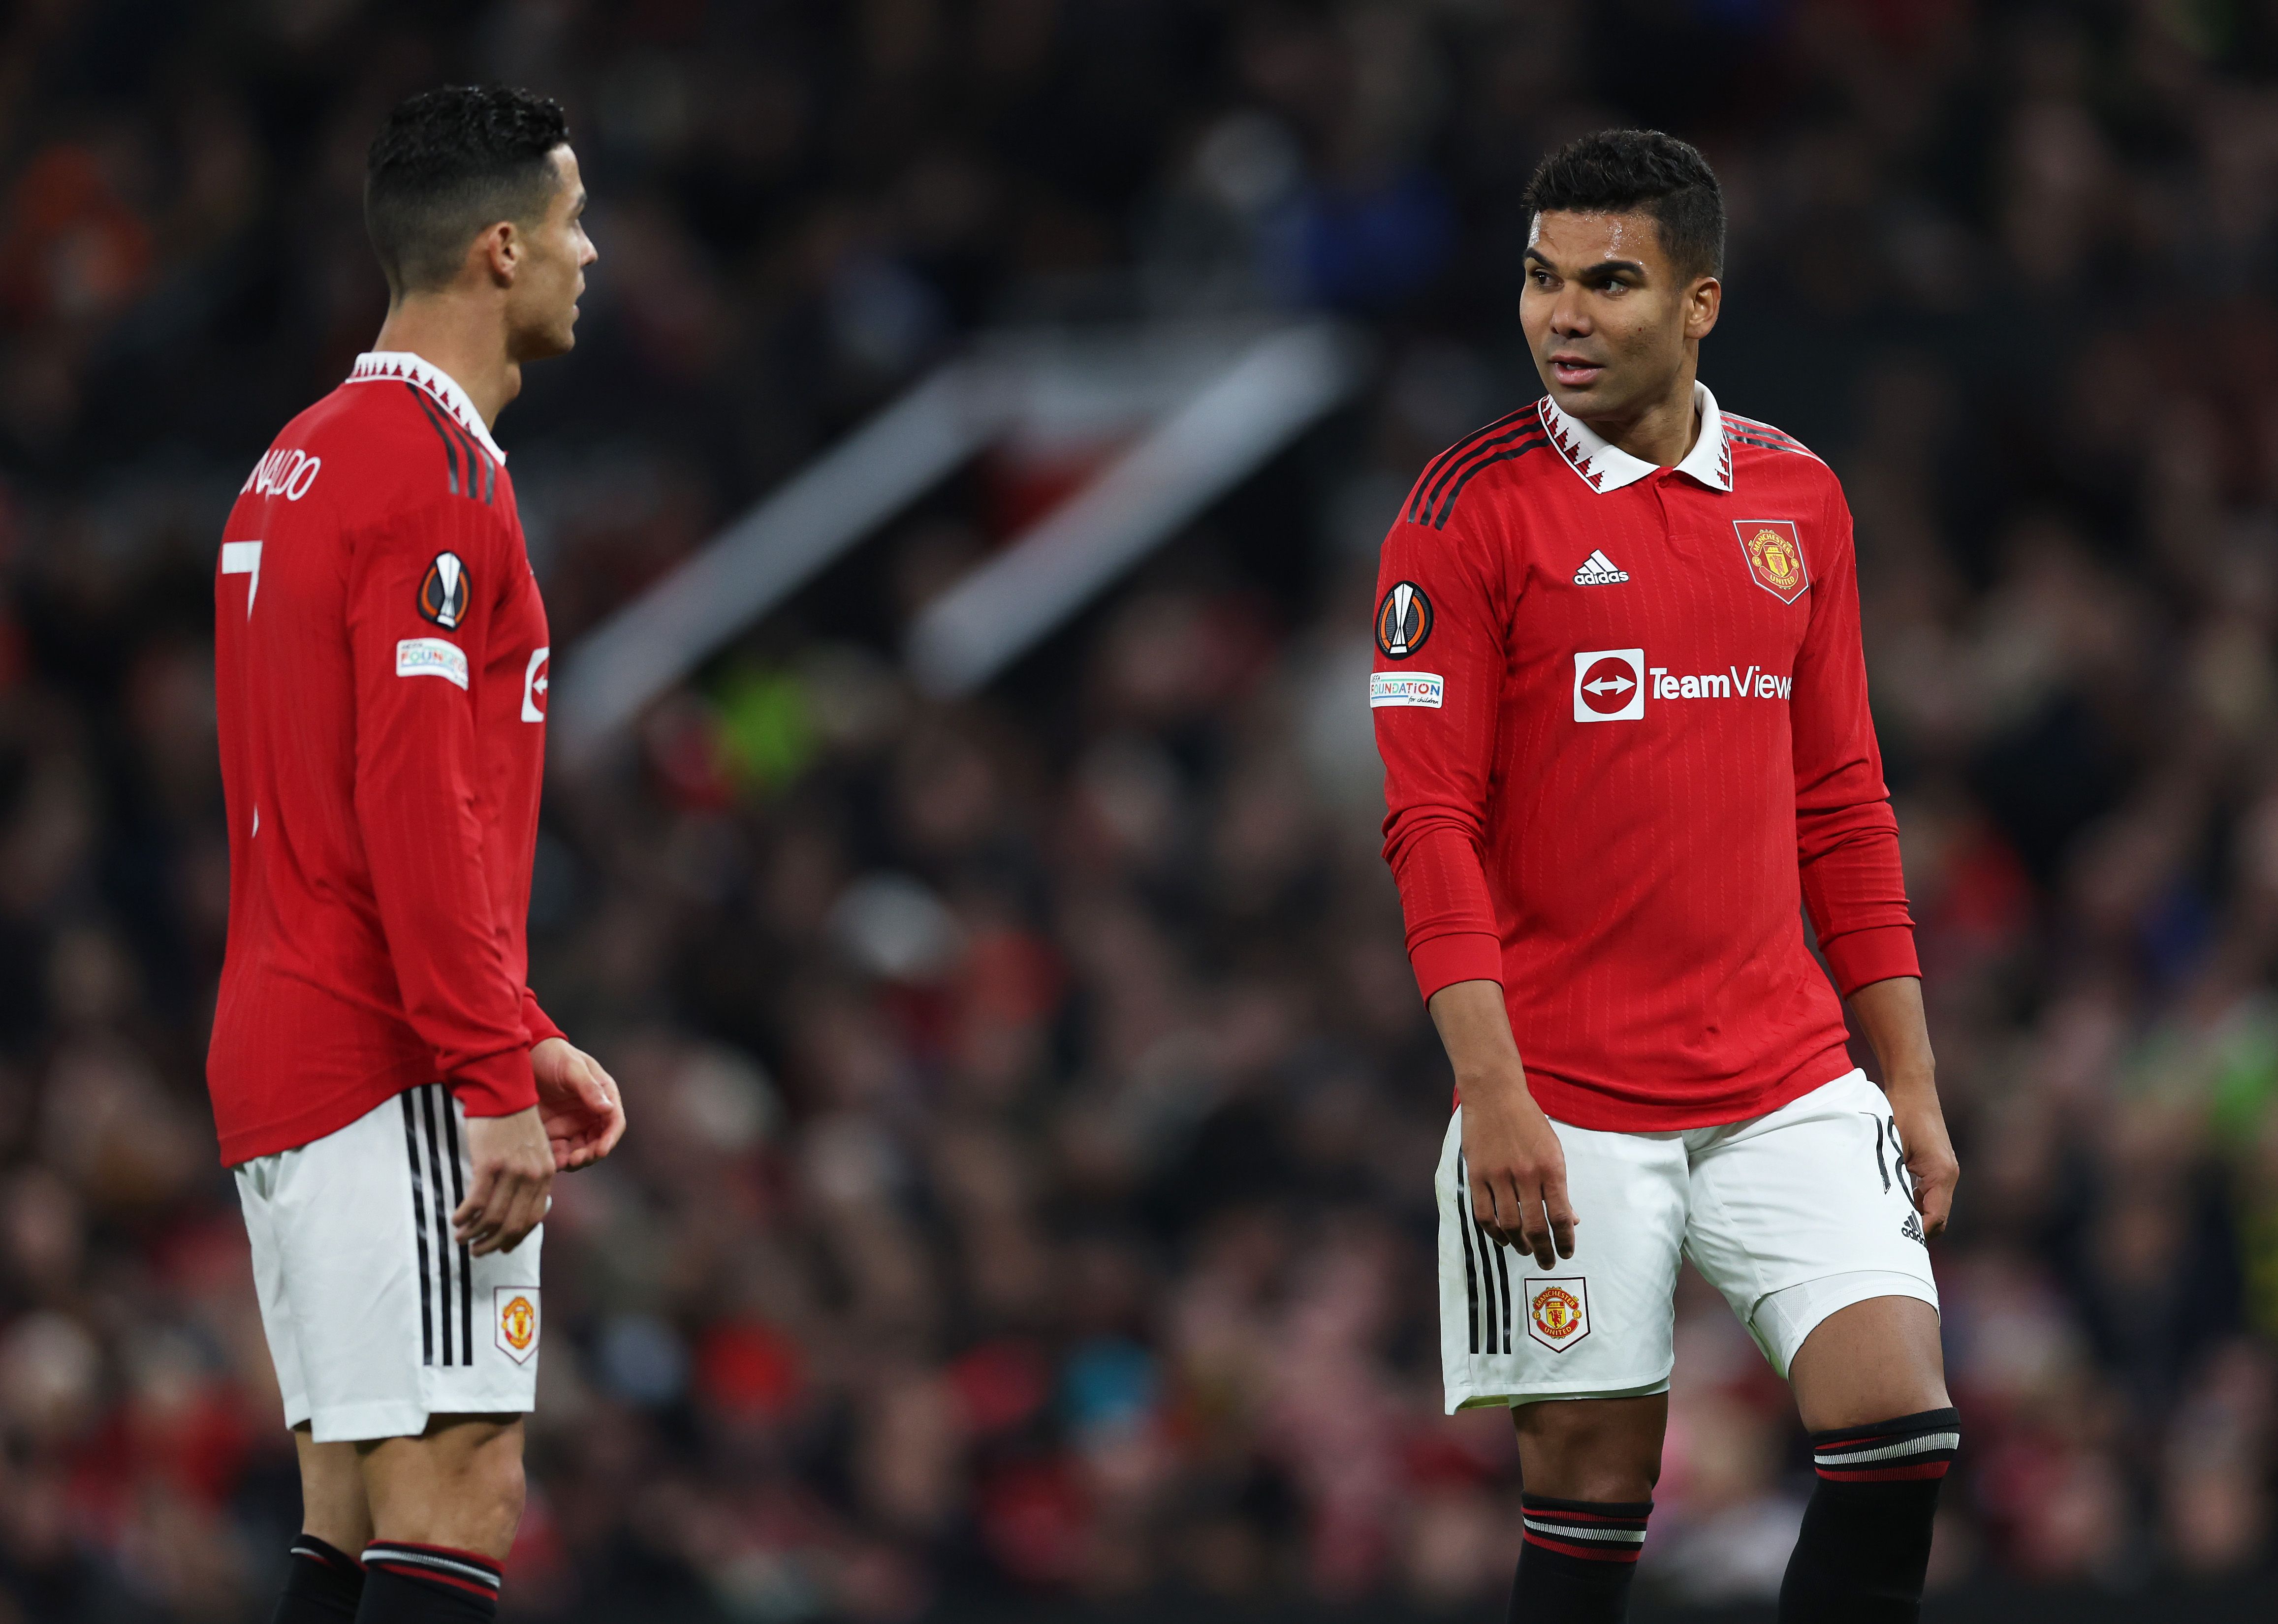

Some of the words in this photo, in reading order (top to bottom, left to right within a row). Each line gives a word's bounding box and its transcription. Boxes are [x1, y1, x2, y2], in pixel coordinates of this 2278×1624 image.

[239, 448, 321, 502] NALDO
[1753, 533, 1792, 554] MANCHESTER
[222, 540, 263, 624] 7
[1574, 571, 1629, 585] adidas
[1770, 574, 1795, 586] UNITED
[1649, 665, 1792, 701] TeamView
[1417, 696, 1439, 705] children
[1901, 1227, 1928, 1249] adida
[1536, 1290, 1576, 1308] MANCHESTER
[1544, 1326, 1572, 1336] UNITED
